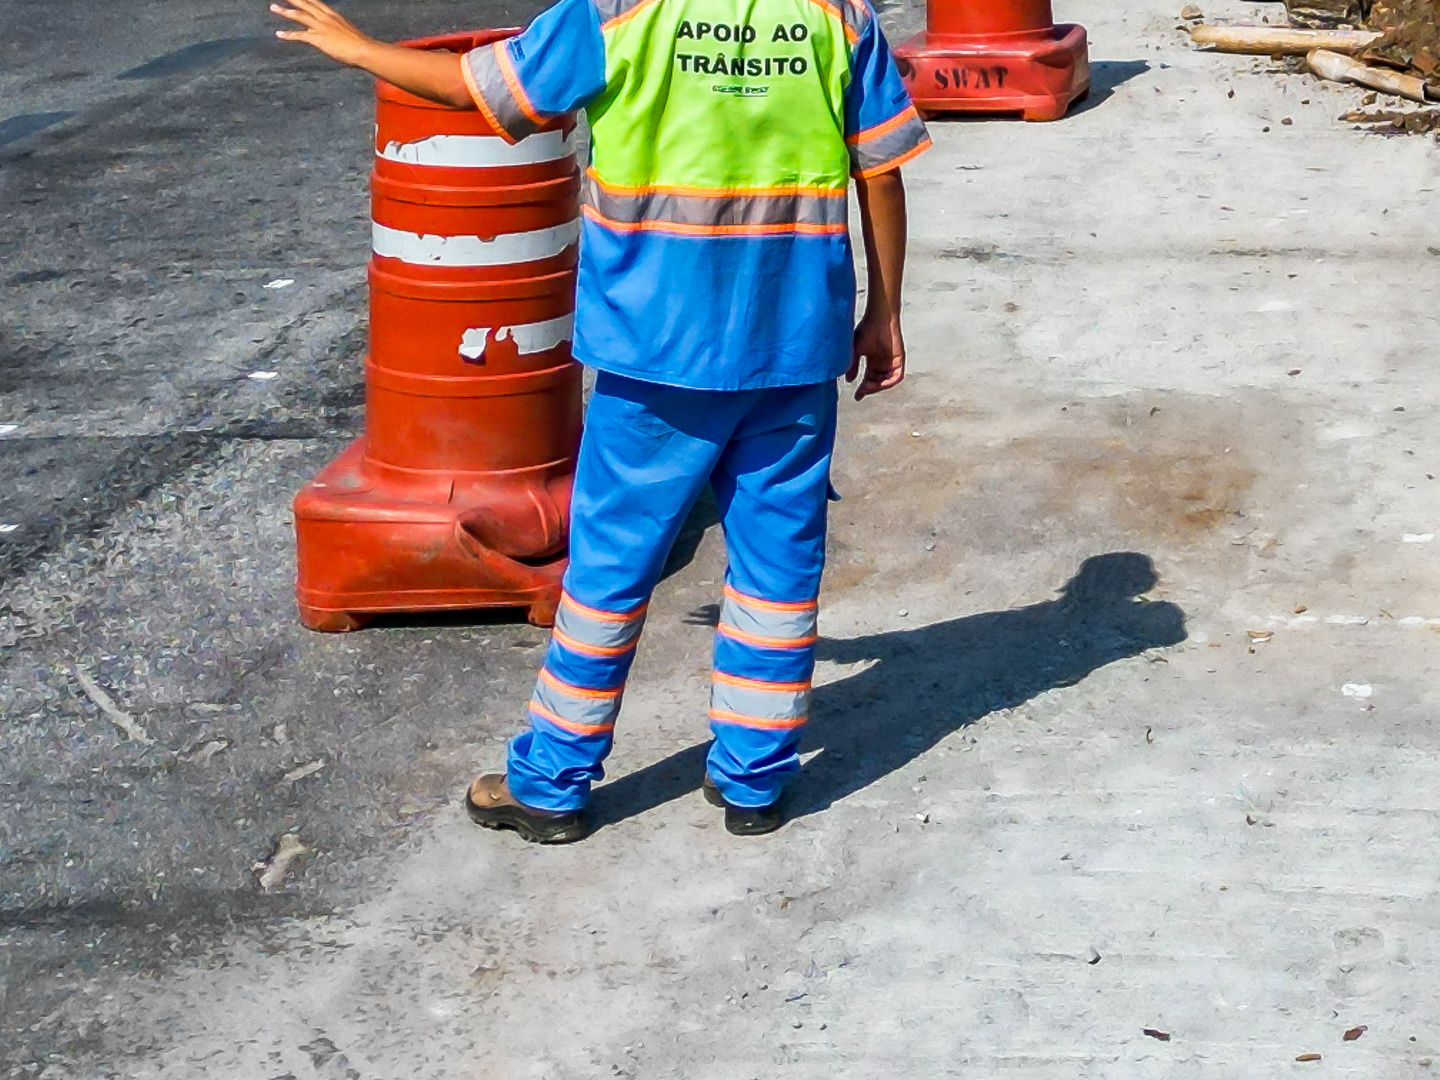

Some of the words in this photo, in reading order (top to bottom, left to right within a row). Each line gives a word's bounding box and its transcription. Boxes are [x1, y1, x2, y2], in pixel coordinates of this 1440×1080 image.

[676, 20, 757, 44] APOIO
[771, 23, 809, 43] AO
[676, 53, 808, 77] TRÂNSITO
[934, 65, 1009, 90] SWAT
